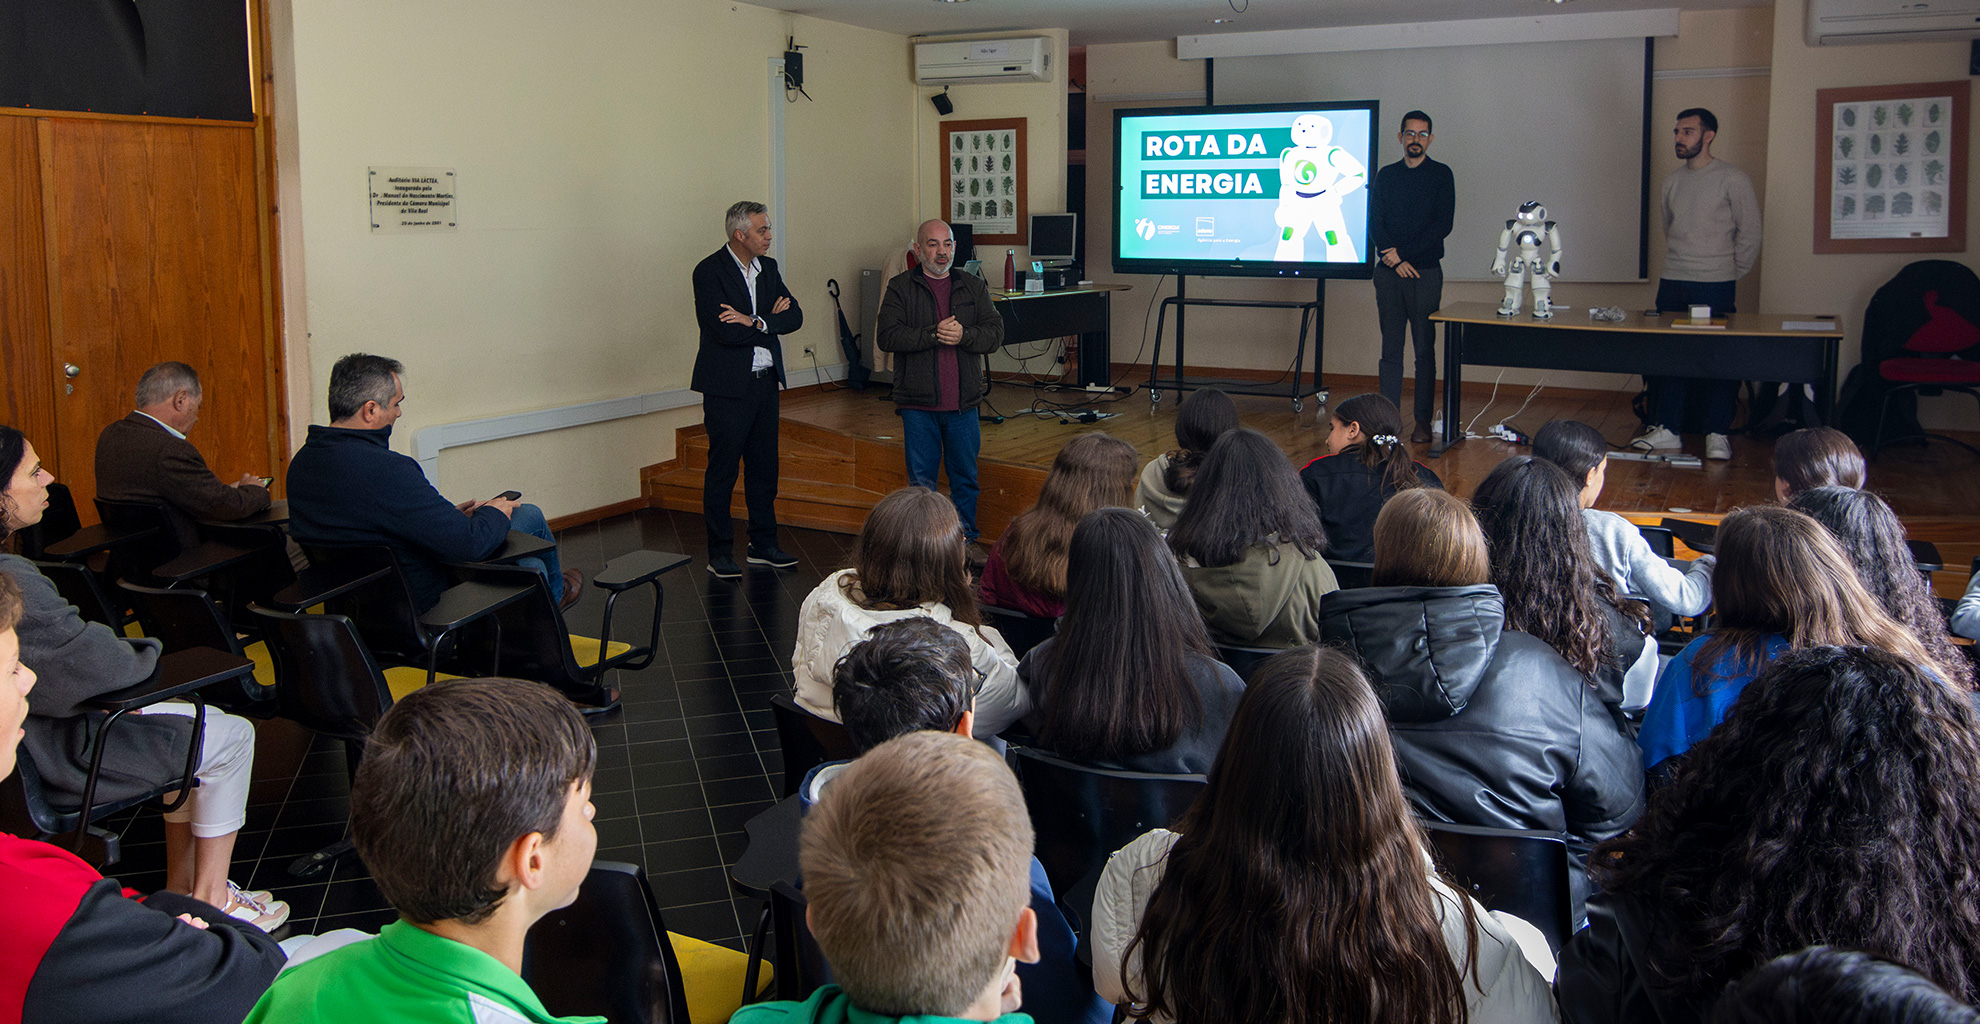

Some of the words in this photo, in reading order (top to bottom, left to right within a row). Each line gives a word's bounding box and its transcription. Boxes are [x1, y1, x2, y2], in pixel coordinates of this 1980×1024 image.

[1146, 134, 1221, 157] ROTA
[1227, 133, 1268, 155] DA
[1146, 172, 1264, 195] ENERGIA
